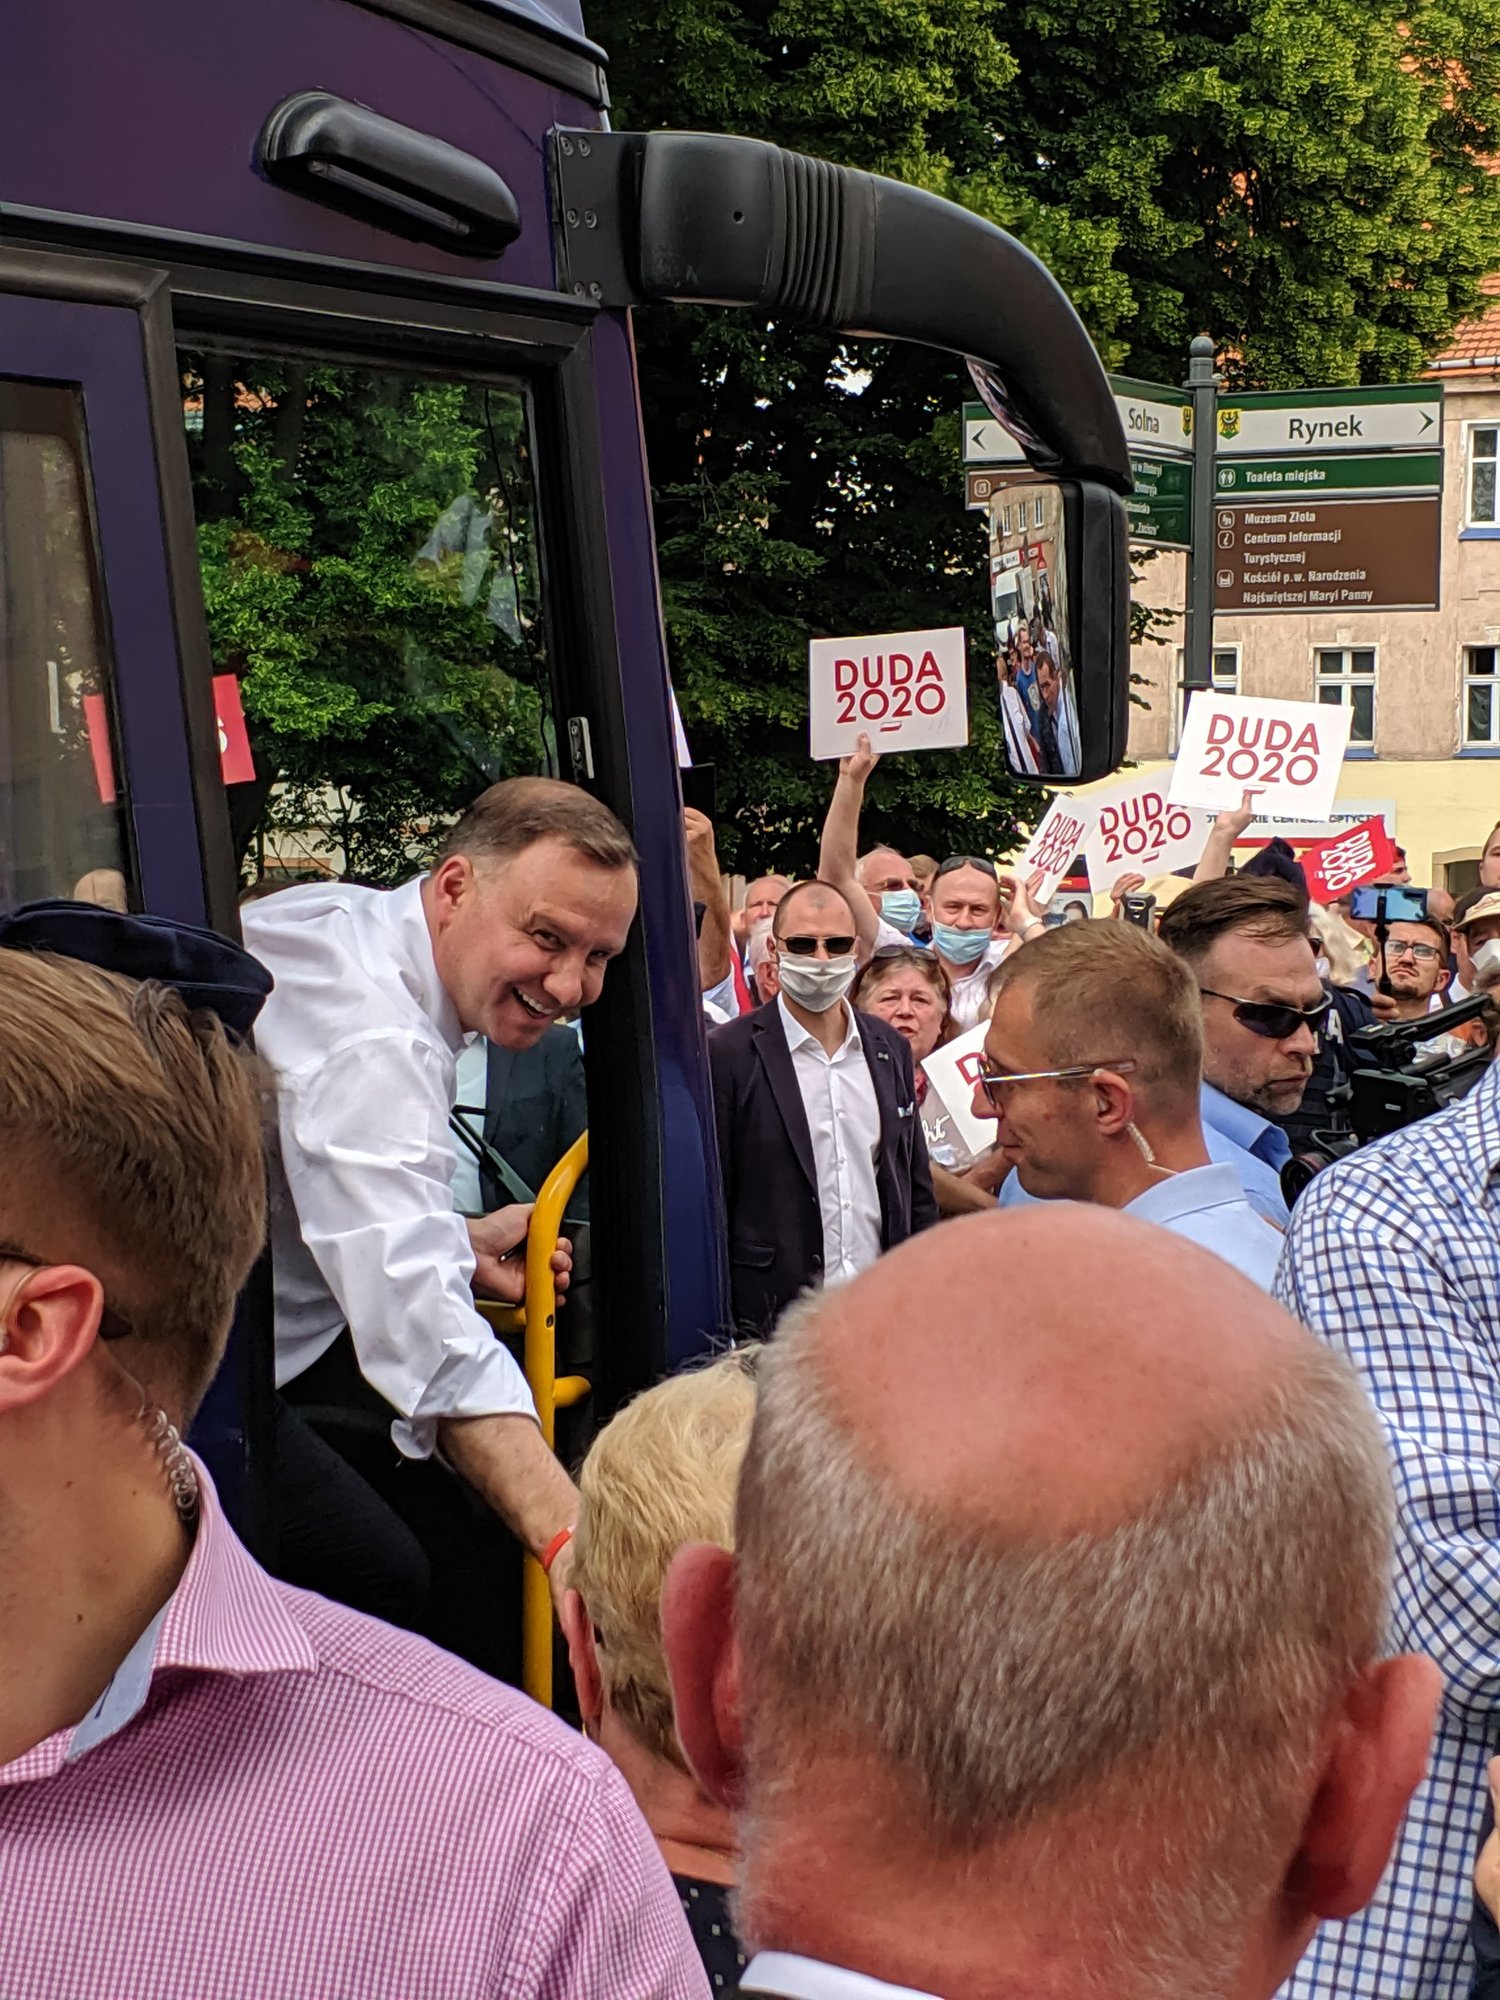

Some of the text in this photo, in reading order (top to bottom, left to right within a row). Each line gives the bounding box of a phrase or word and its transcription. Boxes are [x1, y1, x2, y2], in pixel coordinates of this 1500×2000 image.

[1128, 407, 1160, 433] Solna
[1288, 414, 1363, 445] Rynek
[1245, 470, 1326, 484] Toaleta miejska
[1244, 511, 1316, 525] Muzeum Złota
[1244, 529, 1342, 545] Centrum Informacji
[1243, 551, 1306, 566] Turystycznej
[1243, 569, 1367, 585] Kościół p.w. Narodzenia
[1242, 589, 1373, 605] Najświętszej Maryi Panny
[834, 651, 944, 691] DUDA
[836, 683, 946, 724] 2020
[1206, 713, 1320, 756] DUDA
[1199, 745, 1319, 786] 2020
[1044, 812, 1087, 850] DUDA
[1104, 811, 1192, 863] 2020
[1029, 838, 1076, 876] 2020
[1320, 841, 1353, 891] 2020
[1344, 830, 1377, 881] DUDA
